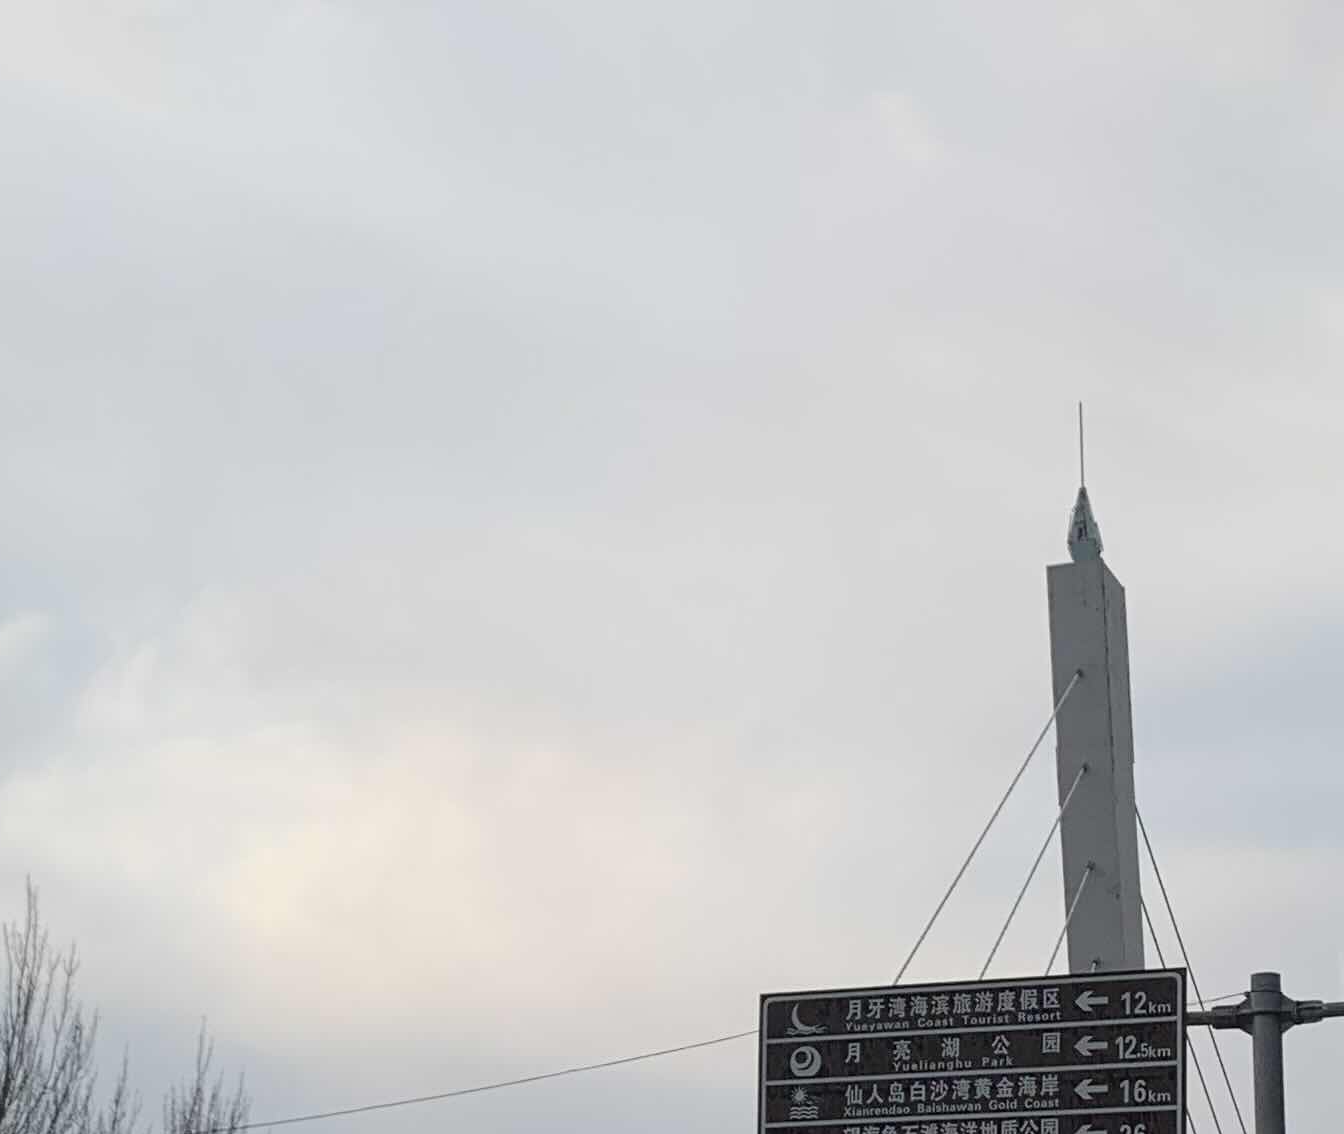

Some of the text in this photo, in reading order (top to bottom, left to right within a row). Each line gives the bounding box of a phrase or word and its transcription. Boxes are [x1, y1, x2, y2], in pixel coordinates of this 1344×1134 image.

[845, 988, 1060, 1020] 月牙湾海滨旅游度假区
[917, 1017, 954, 1028] Coast
[962, 1014, 1009, 1026] Tourist
[1018, 1011, 1061, 1022] Resort
[845, 1033, 1061, 1064] 月亮湖公园
[1115, 1035, 1171, 1059] 12.5km
[892, 1056, 1013, 1072] Yuelianghu Park
[845, 1075, 1060, 1106] 仙人岛白沙湾黄金海岸
[843, 1105, 910, 1117] Xianrendao
[989, 1099, 1017, 1110] Gold
[1024, 1097, 1059, 1109] Coast
